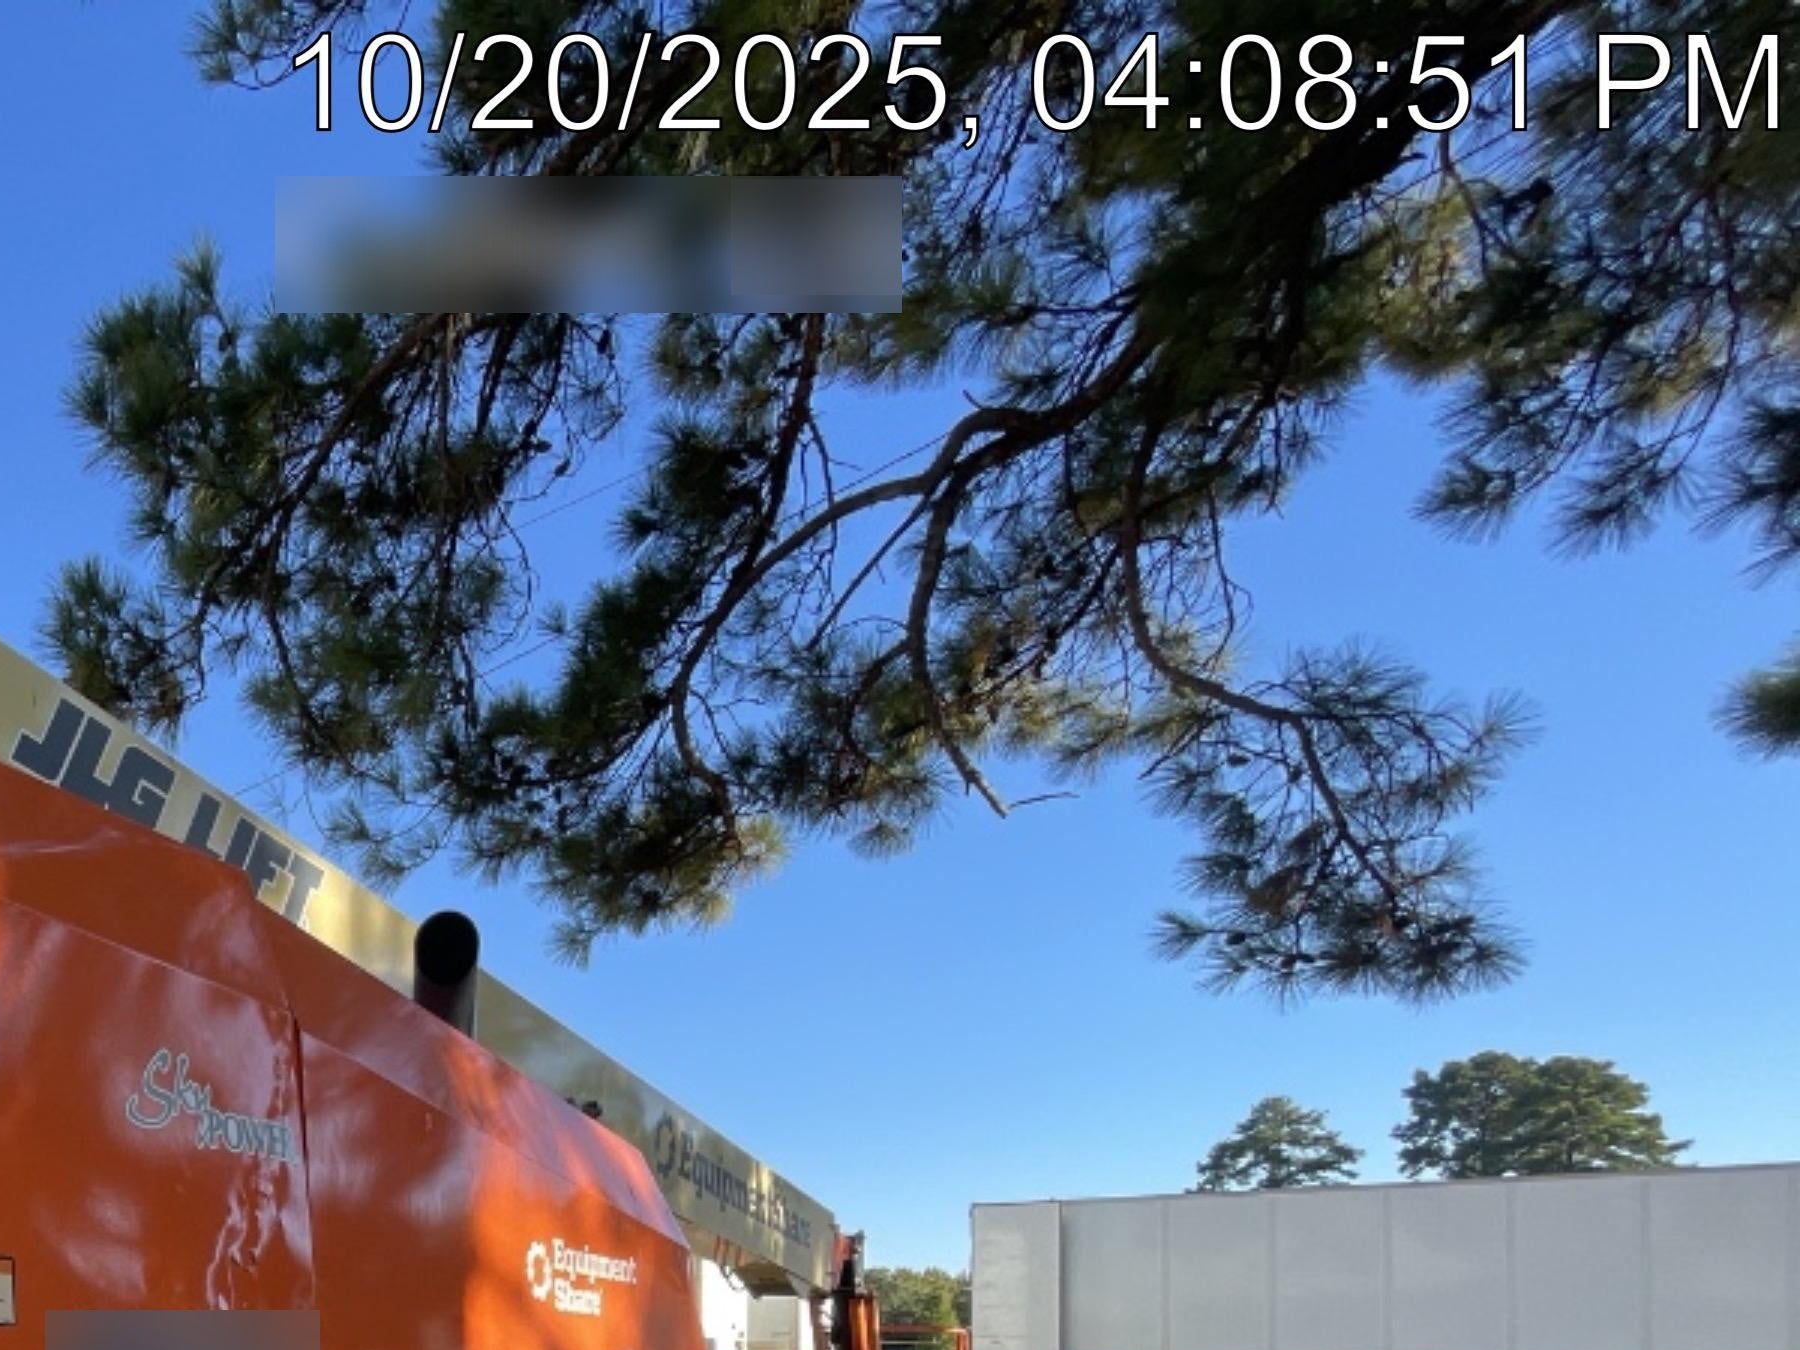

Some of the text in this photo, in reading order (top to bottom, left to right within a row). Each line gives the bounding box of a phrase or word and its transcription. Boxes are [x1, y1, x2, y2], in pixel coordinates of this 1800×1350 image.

[11, 698, 324, 928] JLG LIFT
[551, 1237, 638, 1285] Equipment
[553, 1277, 604, 1316] Share
